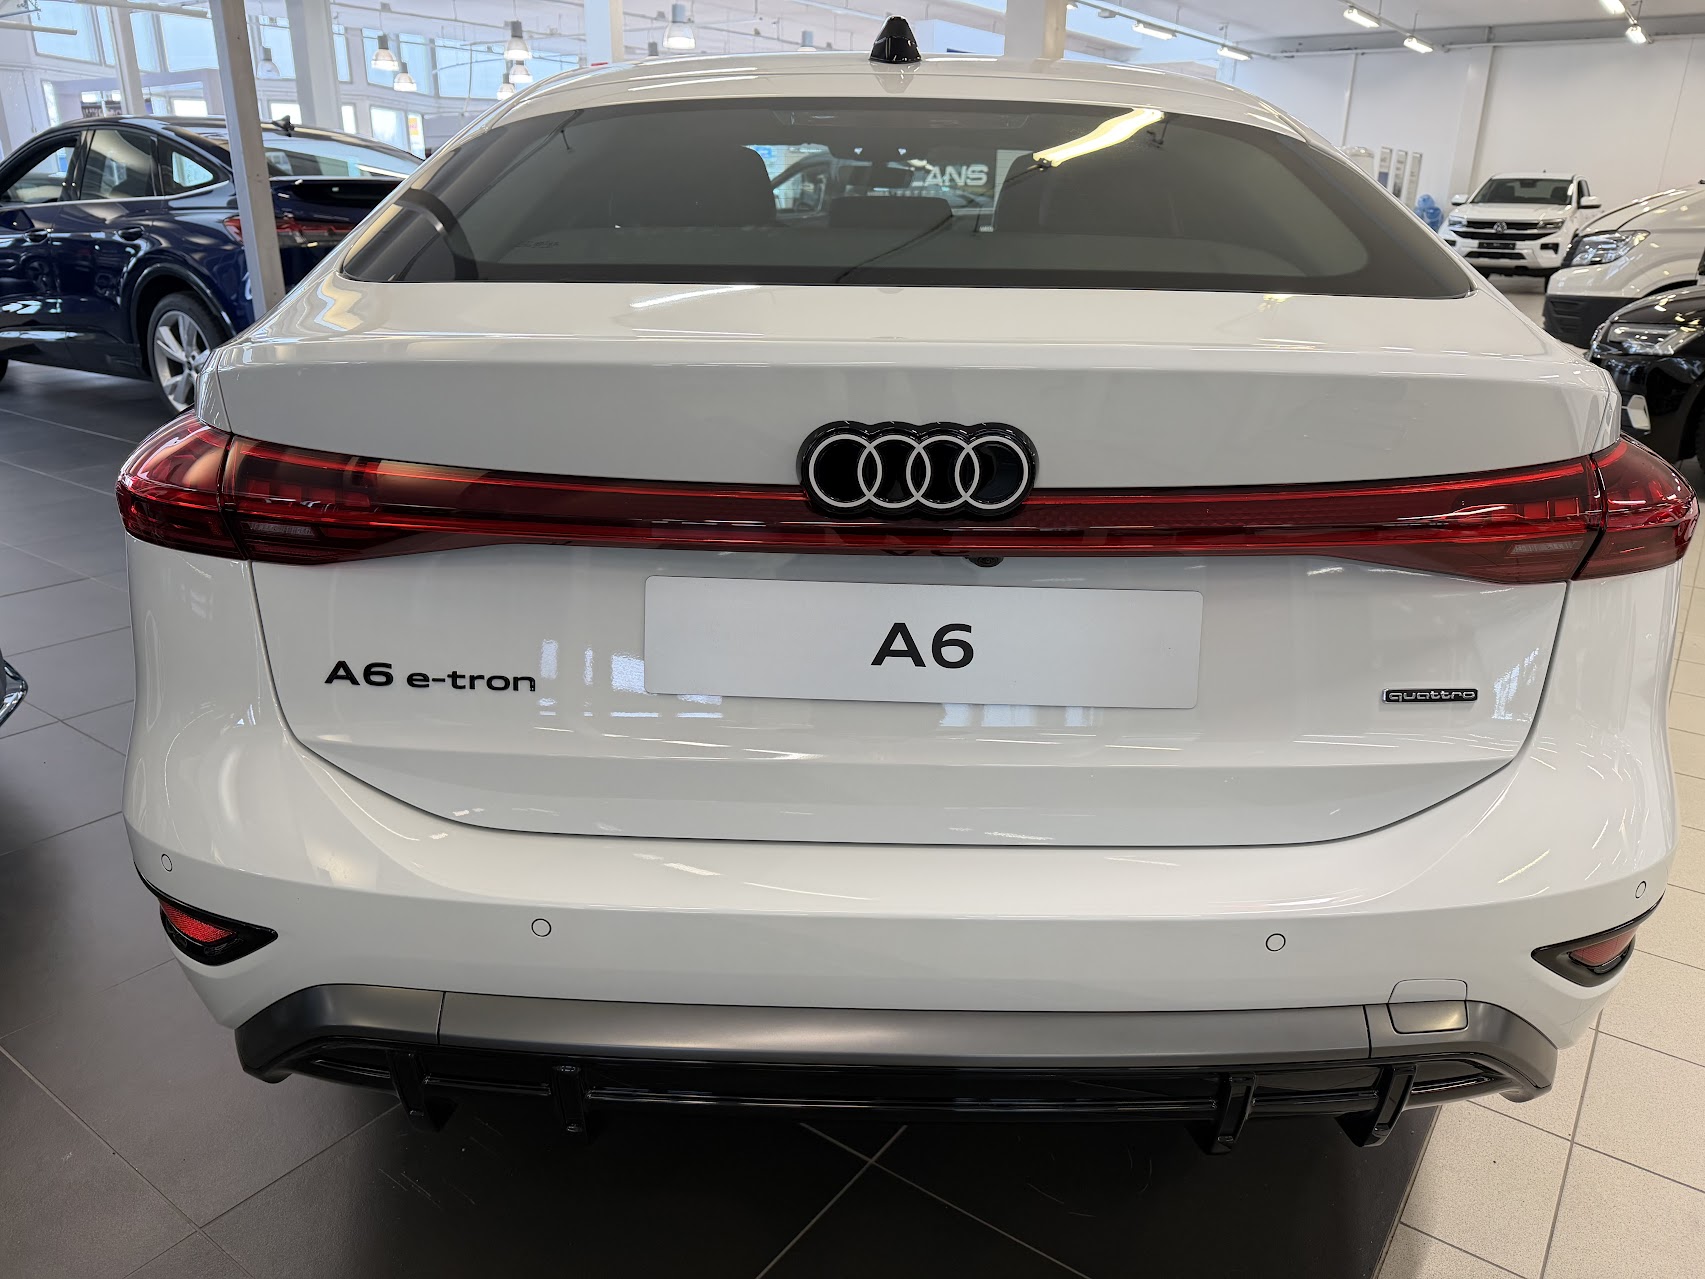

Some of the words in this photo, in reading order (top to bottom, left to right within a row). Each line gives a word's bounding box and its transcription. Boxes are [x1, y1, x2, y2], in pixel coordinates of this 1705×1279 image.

[911, 164, 989, 187] ANS
[870, 622, 974, 670] A6
[324, 660, 394, 687] A6
[406, 670, 536, 692] e-tron
[1388, 690, 1476, 702] quattro
